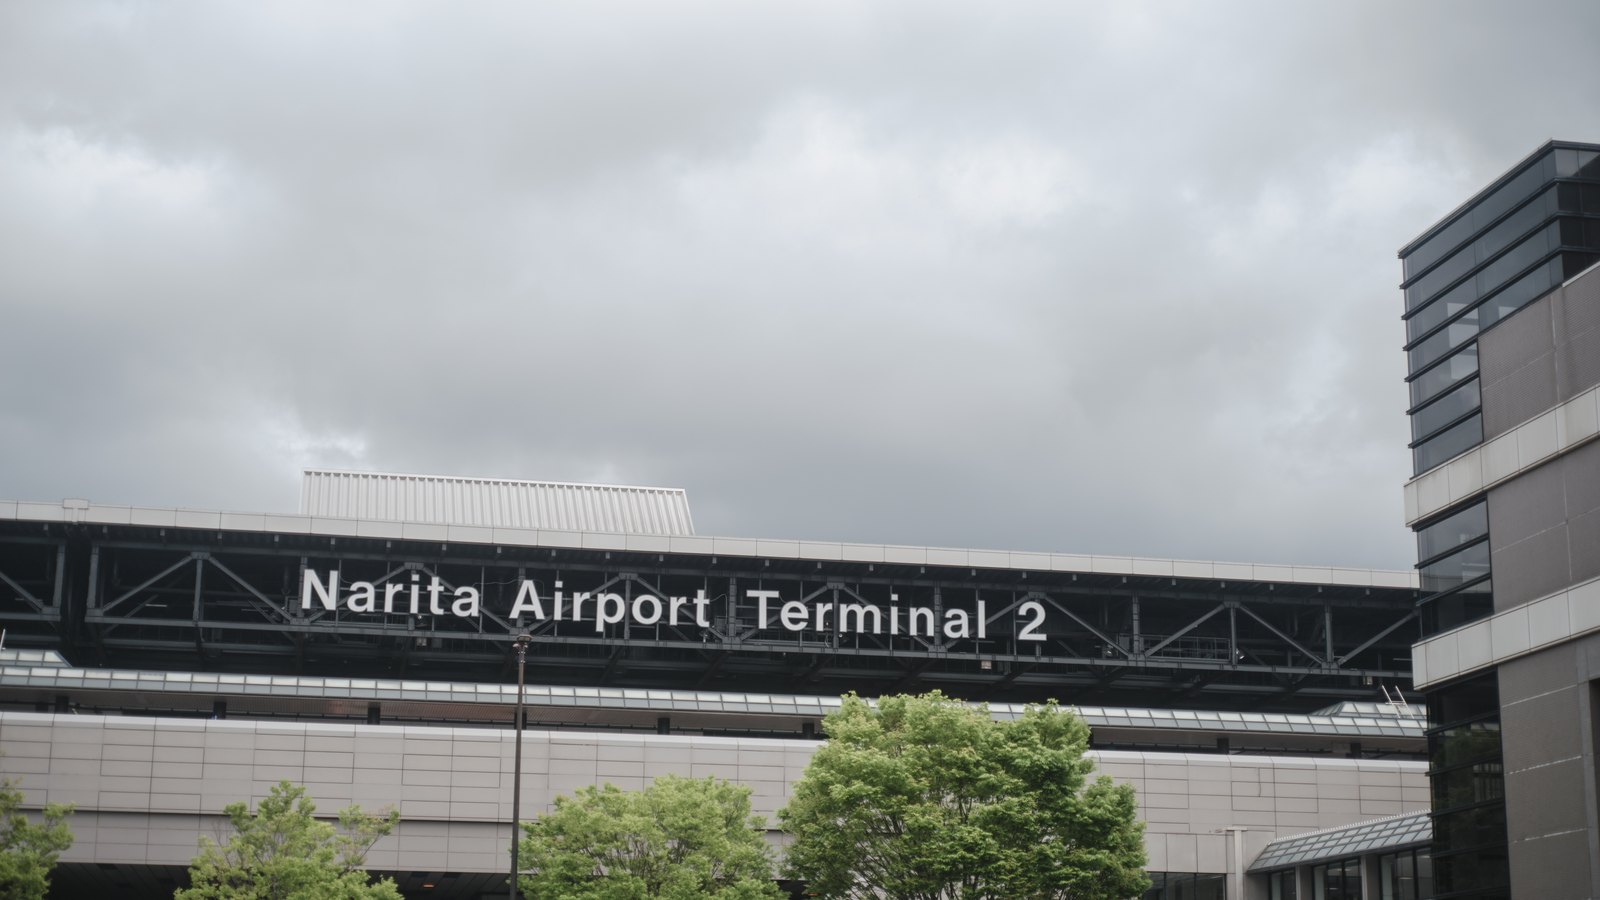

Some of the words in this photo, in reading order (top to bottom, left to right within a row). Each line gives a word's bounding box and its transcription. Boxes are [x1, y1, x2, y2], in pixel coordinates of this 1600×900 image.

[301, 568, 480, 617] Narita
[508, 579, 710, 632] Airport
[746, 589, 987, 639] Terminal
[1017, 600, 1048, 642] 2
